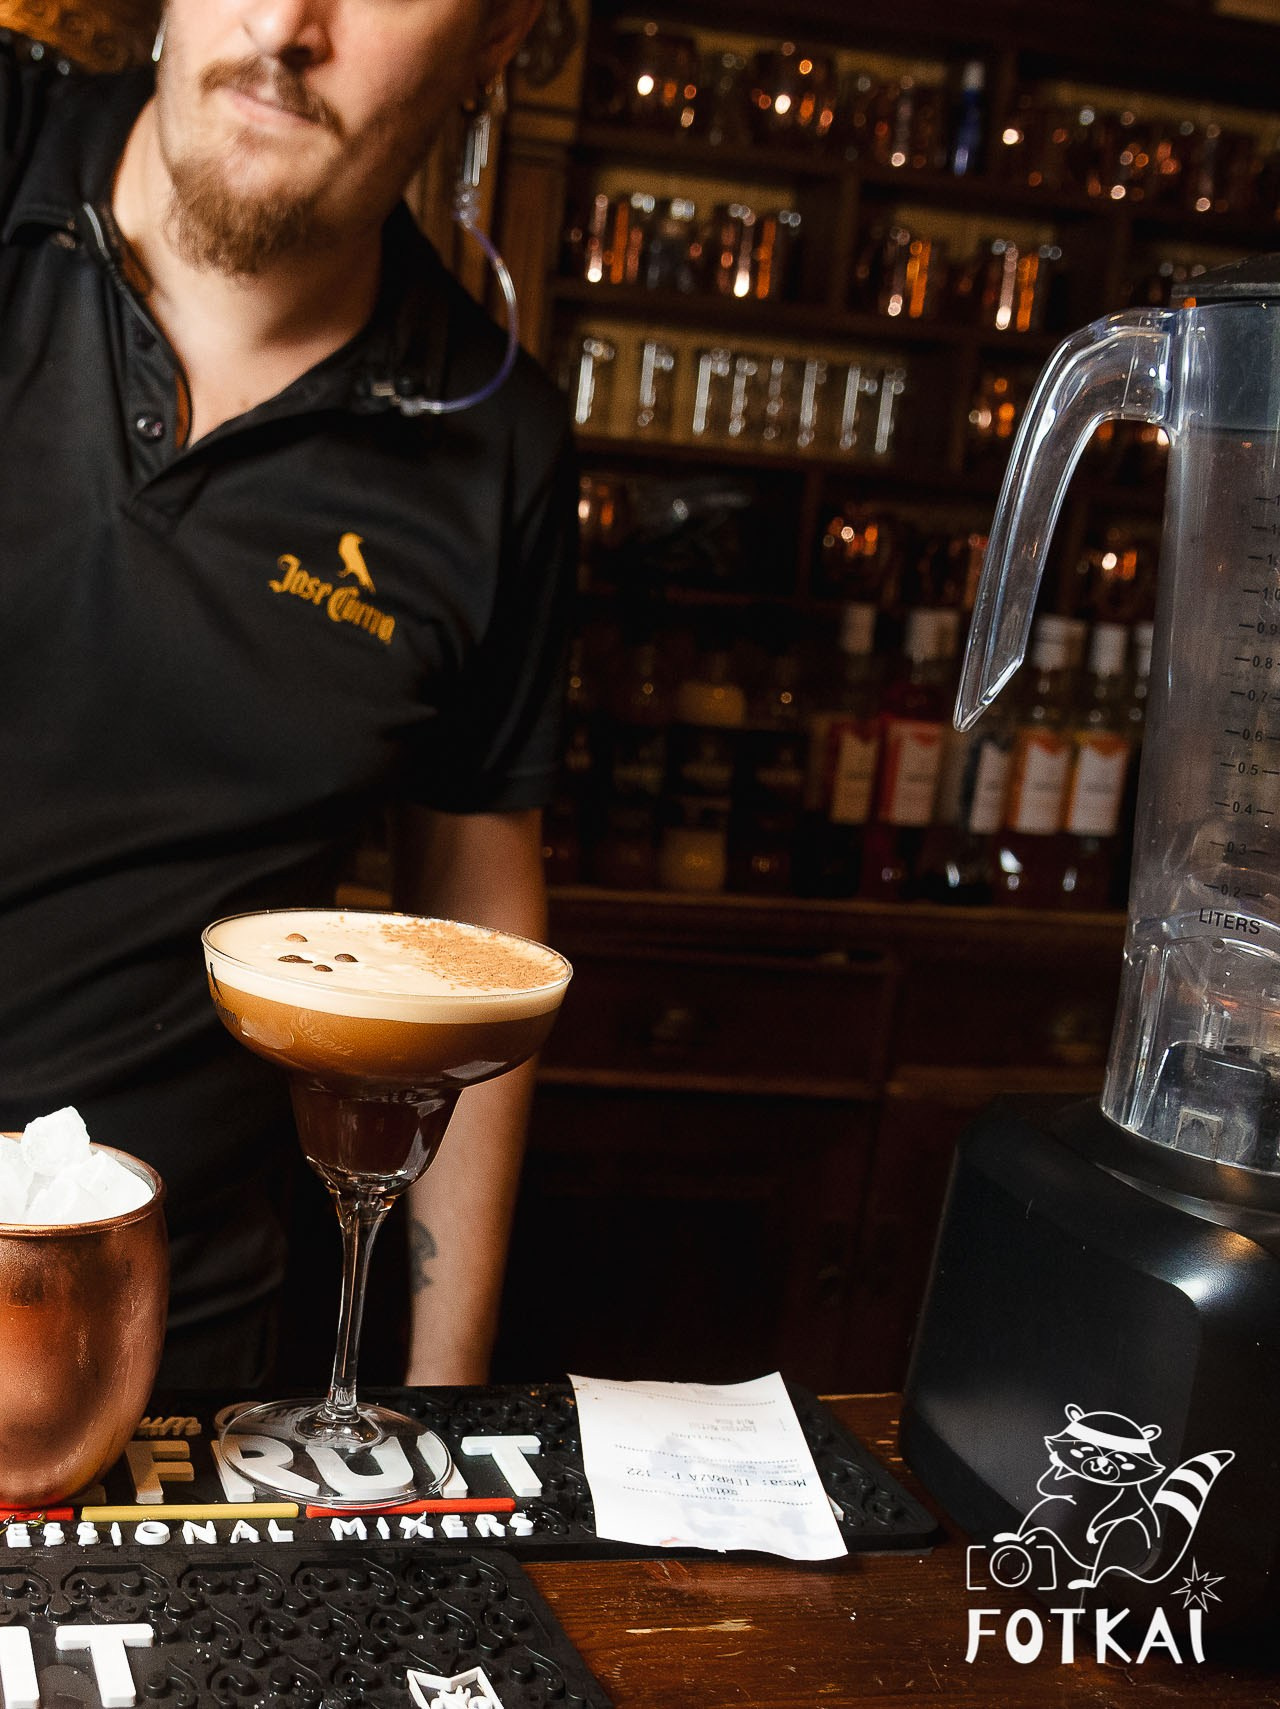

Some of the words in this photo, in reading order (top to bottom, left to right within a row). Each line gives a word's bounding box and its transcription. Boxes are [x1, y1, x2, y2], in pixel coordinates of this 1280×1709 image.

[1257, 621, 1278, 636] 0.9
[1252, 655, 1273, 669] 0.8
[1247, 689, 1268, 703] 0.7
[1242, 728, 1262, 742] 0.6
[1238, 762, 1258, 776] 0.5
[1232, 801, 1252, 814] 0.4
[1227, 841, 1247, 855] 0.3
[1220, 884, 1240, 898] 0.2
[1199, 908, 1261, 935] LITERS
[329, 1511, 535, 1541] MIXERS
